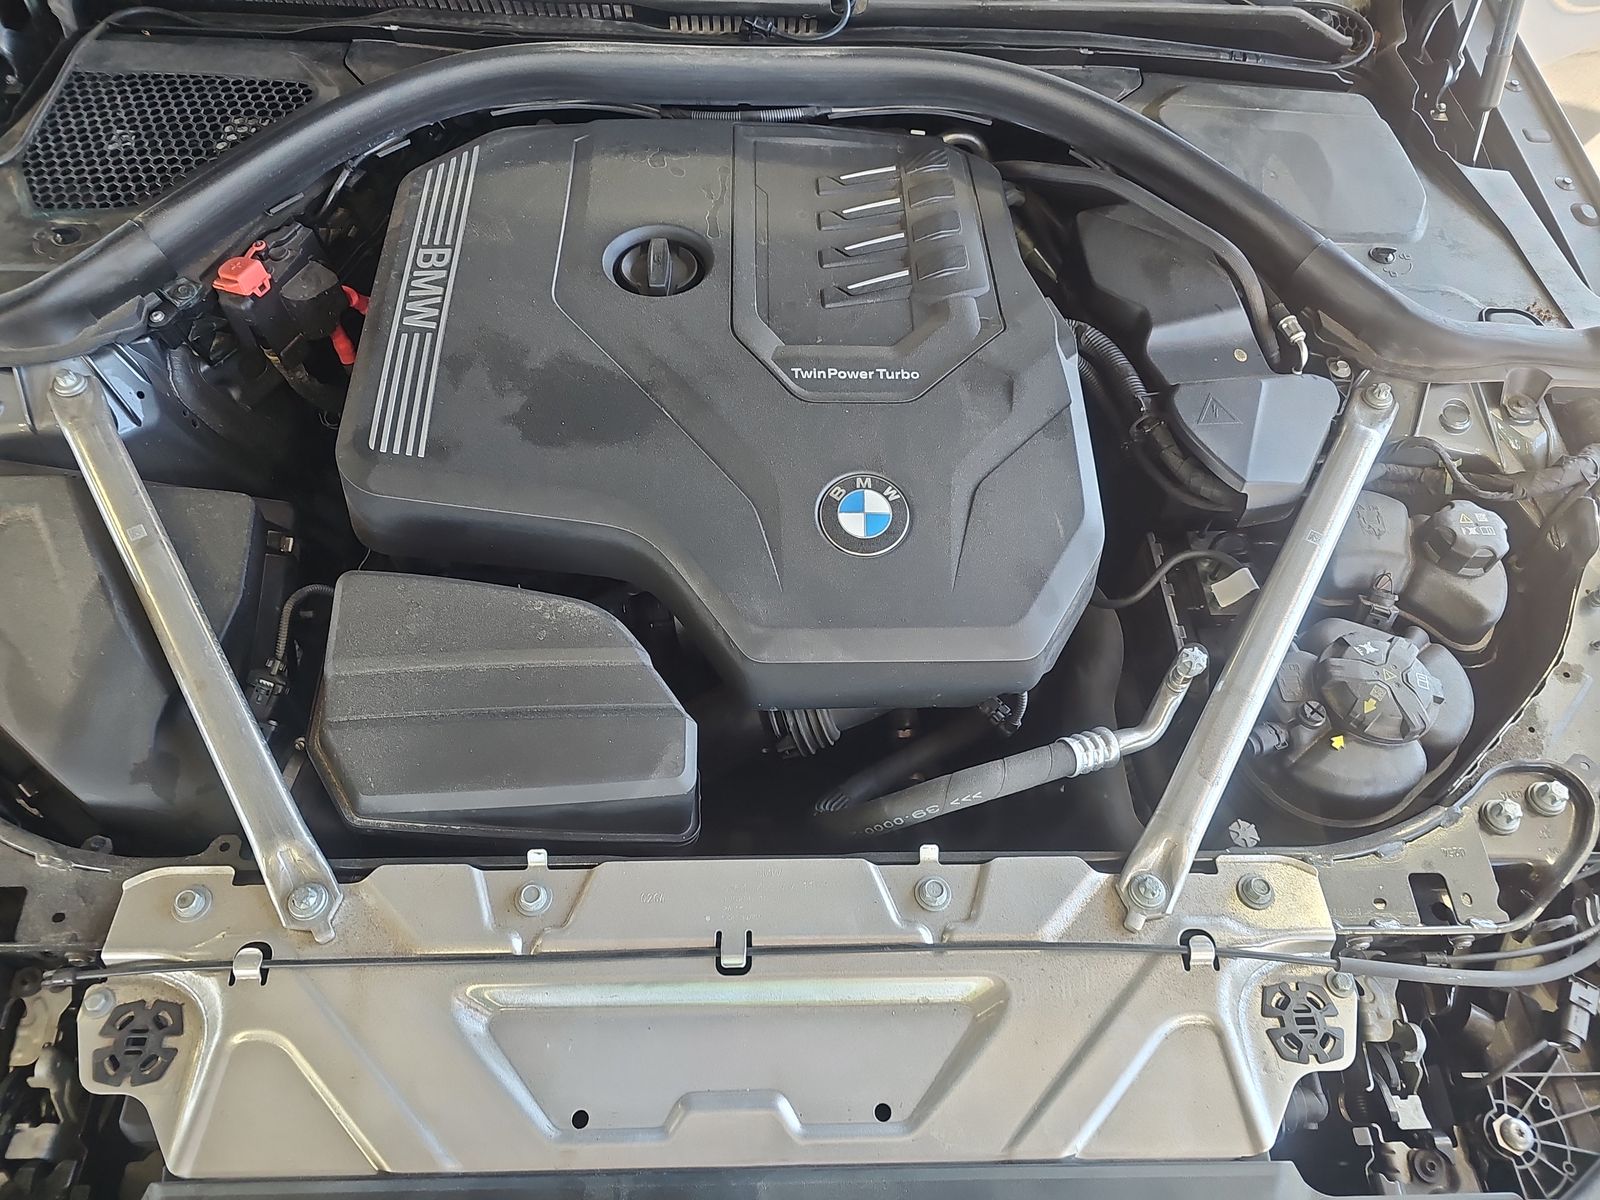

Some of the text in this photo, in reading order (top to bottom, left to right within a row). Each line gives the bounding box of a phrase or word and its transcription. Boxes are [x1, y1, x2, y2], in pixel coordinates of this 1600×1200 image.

[402, 248, 452, 329] BMW
[876, 368, 920, 380] Turbo
[829, 477, 901, 502] BMW
